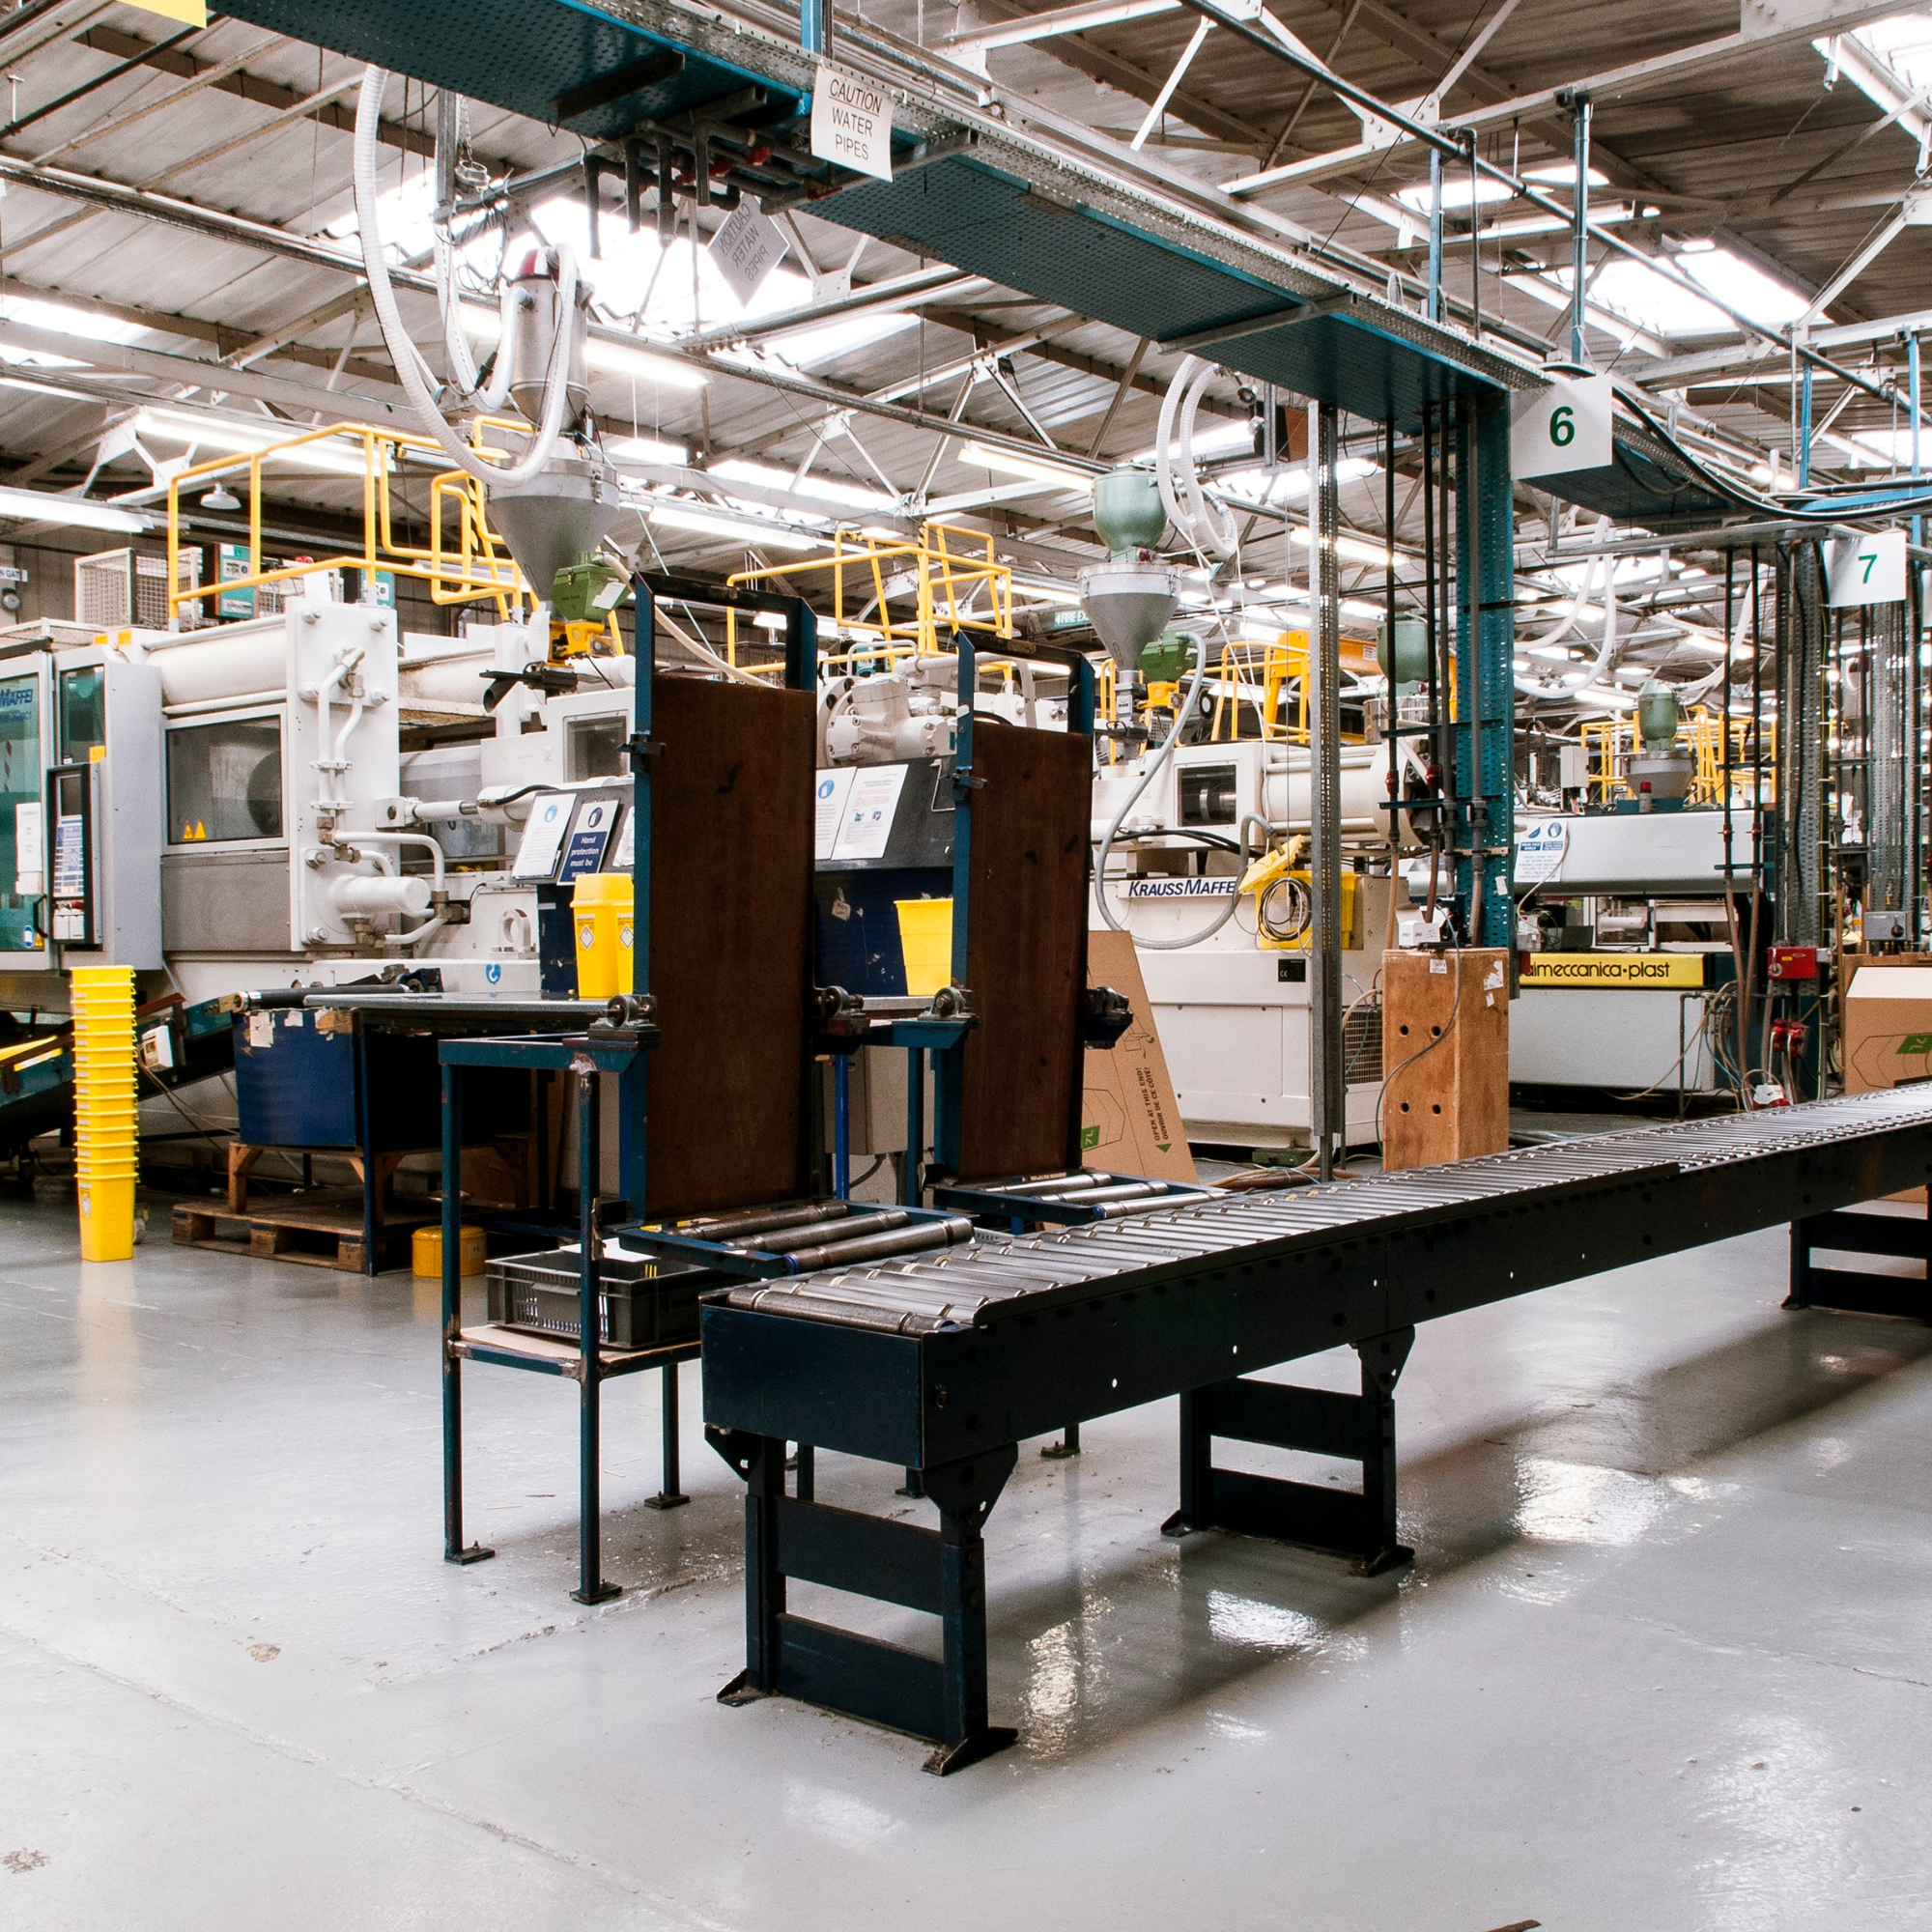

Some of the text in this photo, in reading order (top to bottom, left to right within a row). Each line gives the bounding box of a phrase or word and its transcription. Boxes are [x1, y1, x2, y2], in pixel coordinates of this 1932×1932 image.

[830, 78, 883, 114] CAUTION
[832, 106, 873, 138] WATER
[835, 133, 869, 160] PIPES
[1549, 406, 1576, 446] 6
[1858, 554, 1877, 584] 7
[1061, 611, 1077, 624] FIRE
[571, 847, 599, 857] protection
[584, 857, 593, 867] be
[1128, 879, 1237, 896] KRAUSSMAFFE
[1135, 1067, 1160, 1141] OPEN AT THIS END!
[1144, 1066, 1169, 1140] OUVRIR DE CE CÔTÉ!
